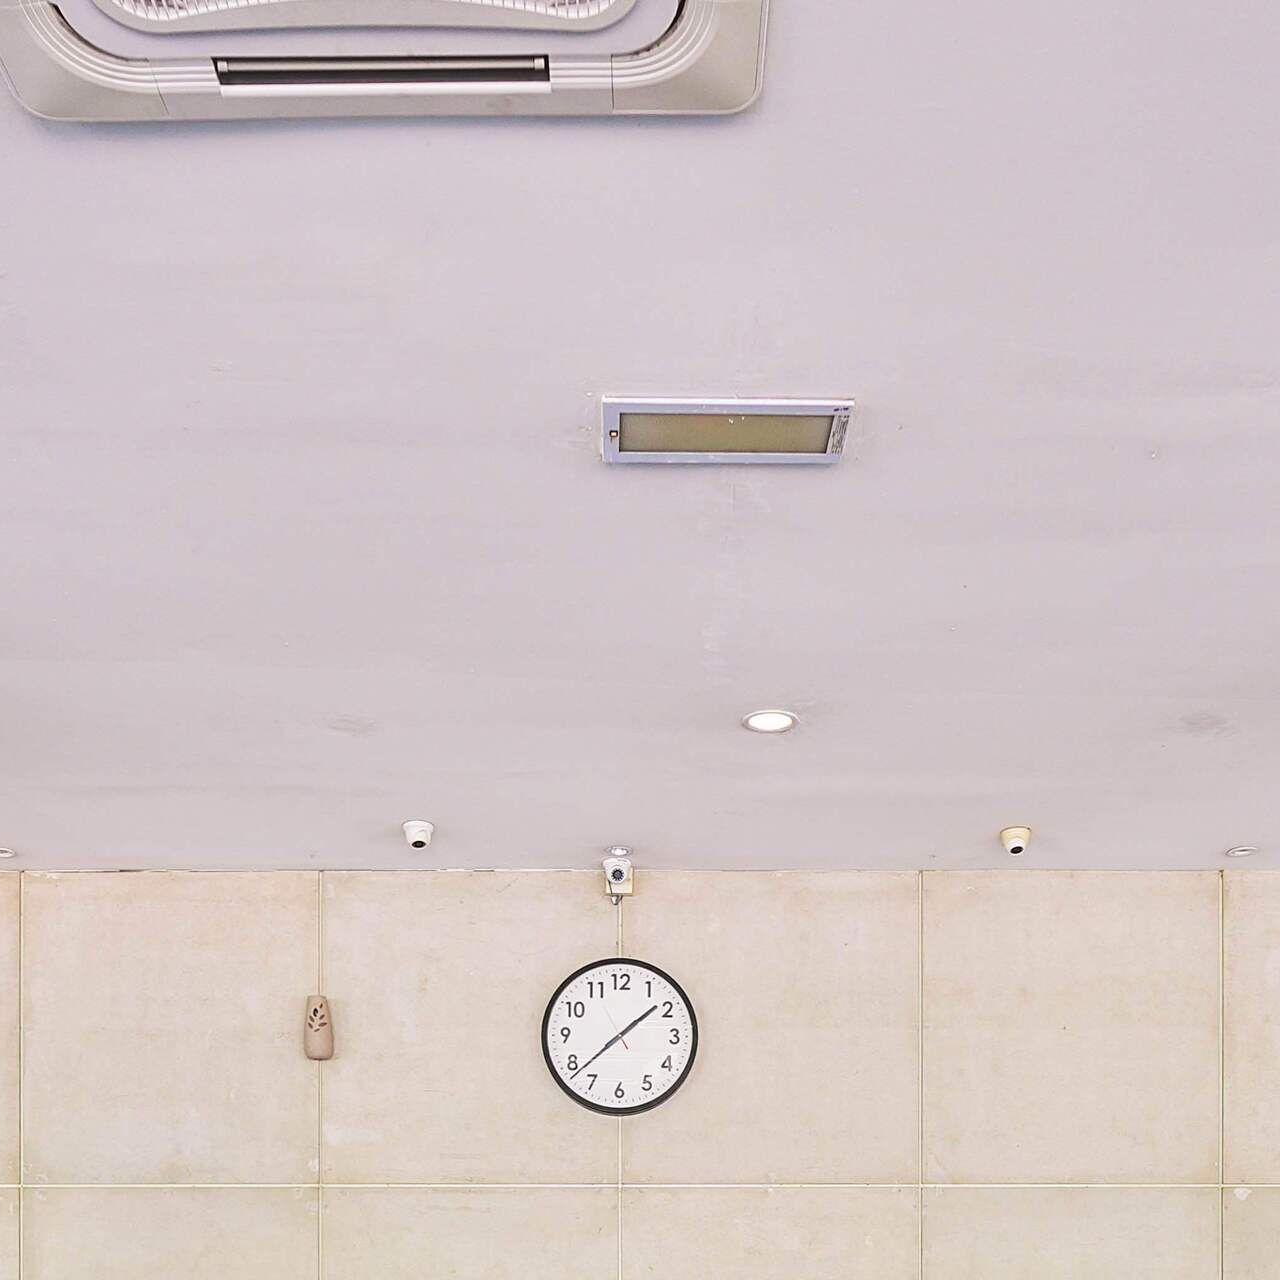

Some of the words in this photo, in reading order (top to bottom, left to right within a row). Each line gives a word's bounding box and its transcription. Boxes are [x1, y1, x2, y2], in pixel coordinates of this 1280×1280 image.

[587, 981, 604, 998] 11
[611, 973, 631, 991] 12
[645, 981, 652, 998] 1
[566, 1001, 585, 1018] 10
[661, 1001, 673, 1018] 2
[560, 1027, 571, 1044] 9
[669, 1028, 680, 1045] 3
[567, 1054, 578, 1071] 8
[661, 1055, 673, 1072] 4
[587, 1074, 598, 1090] 7
[614, 1081, 625, 1098] 6
[641, 1075, 653, 1091] 5
